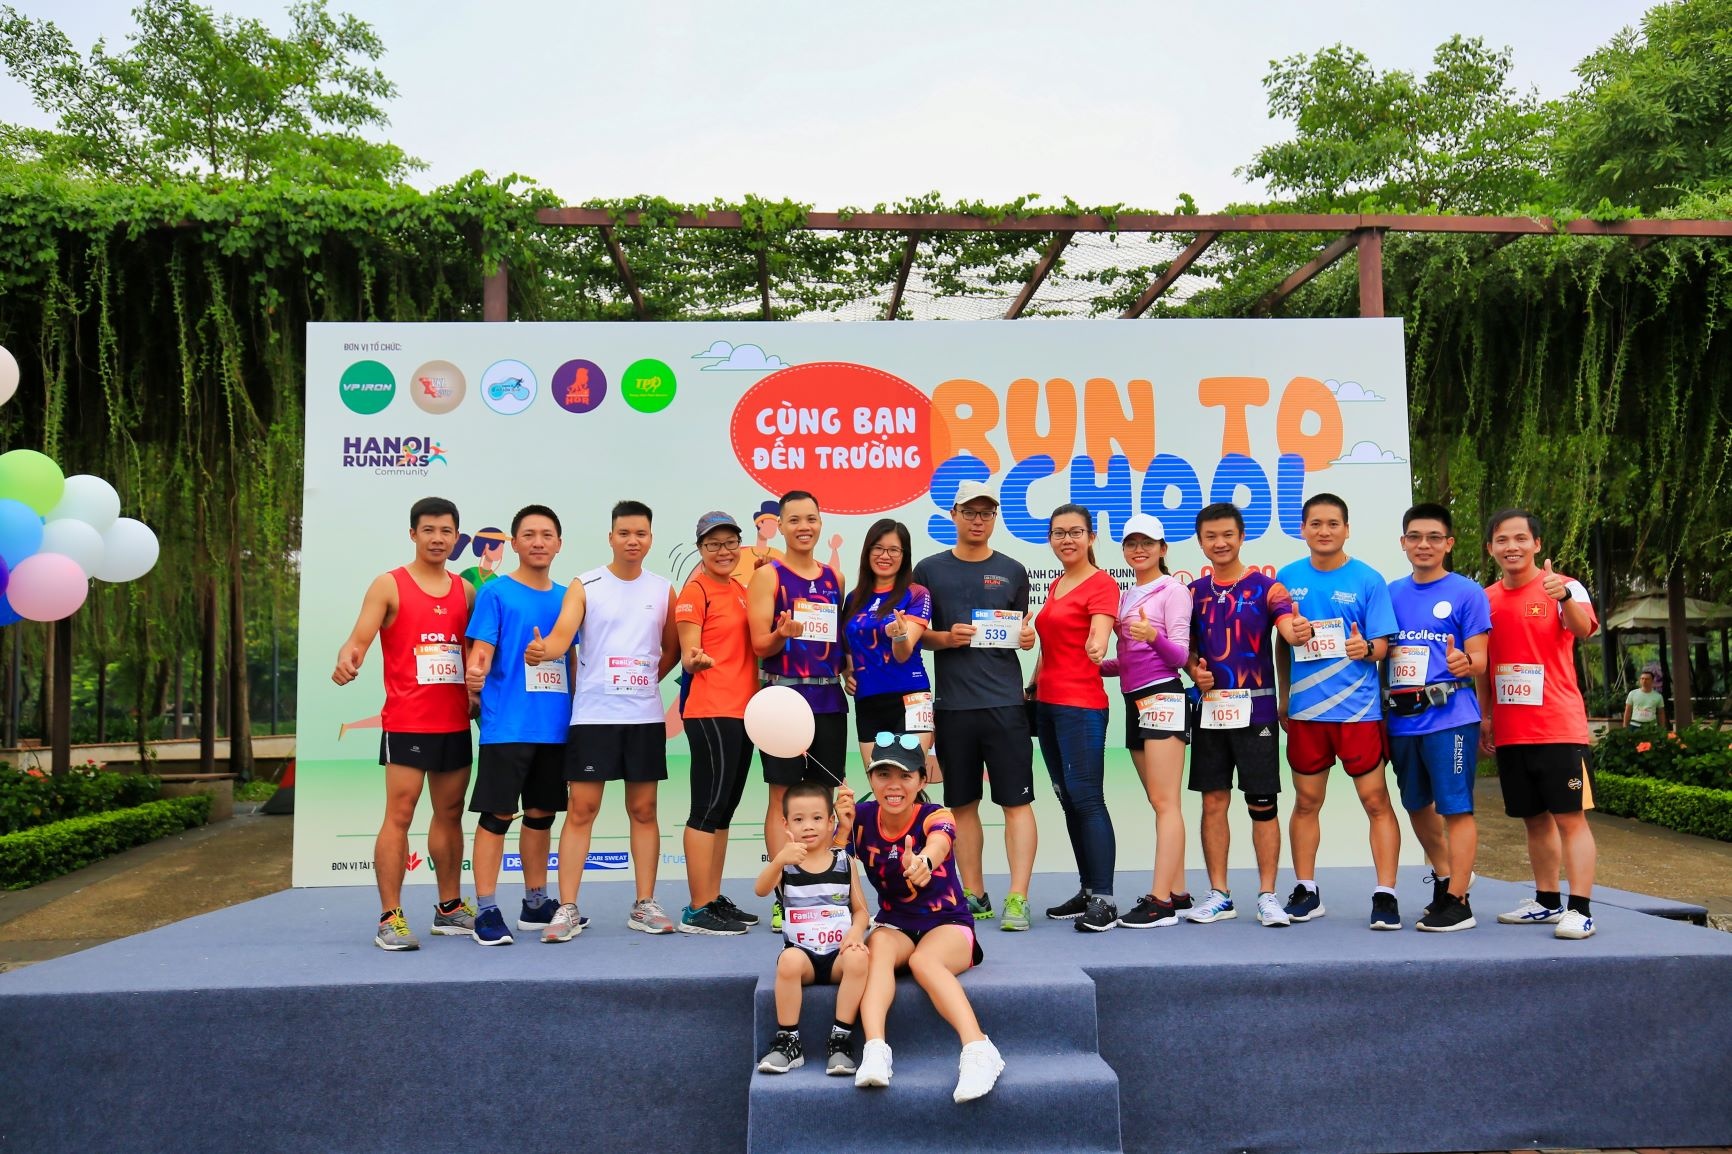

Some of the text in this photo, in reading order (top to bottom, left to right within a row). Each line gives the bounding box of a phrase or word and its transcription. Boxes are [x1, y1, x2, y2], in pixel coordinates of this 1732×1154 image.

[343, 383, 392, 391] VP IRON
[755, 400, 916, 441] CÙNG BẠN
[929, 376, 1344, 476] RUN TO
[343, 436, 431, 454] HANOI
[751, 436, 921, 470] ĐẾN TRƯỜNG
[343, 455, 430, 467] RUNNERS
[374, 468, 429, 477] Community
[927, 453, 1306, 546] SCHOOL
[1027, 567, 1047, 579] ÀNH
[1109, 568, 1135, 578] RUNN
[802, 620, 829, 634] 1056
[420, 632, 458, 643] FOR A
[985, 628, 1007, 640] 539
[1304, 638, 1336, 653] 1055
[428, 663, 458, 675] 1054
[1393, 665, 1416, 678] 1063
[535, 671, 561, 685] 1052
[1501, 684, 1531, 696] 1049
[1145, 710, 1175, 722] 1057
[1211, 708, 1240, 721] 1051
[1456, 734, 1465, 774] ZENNIO
